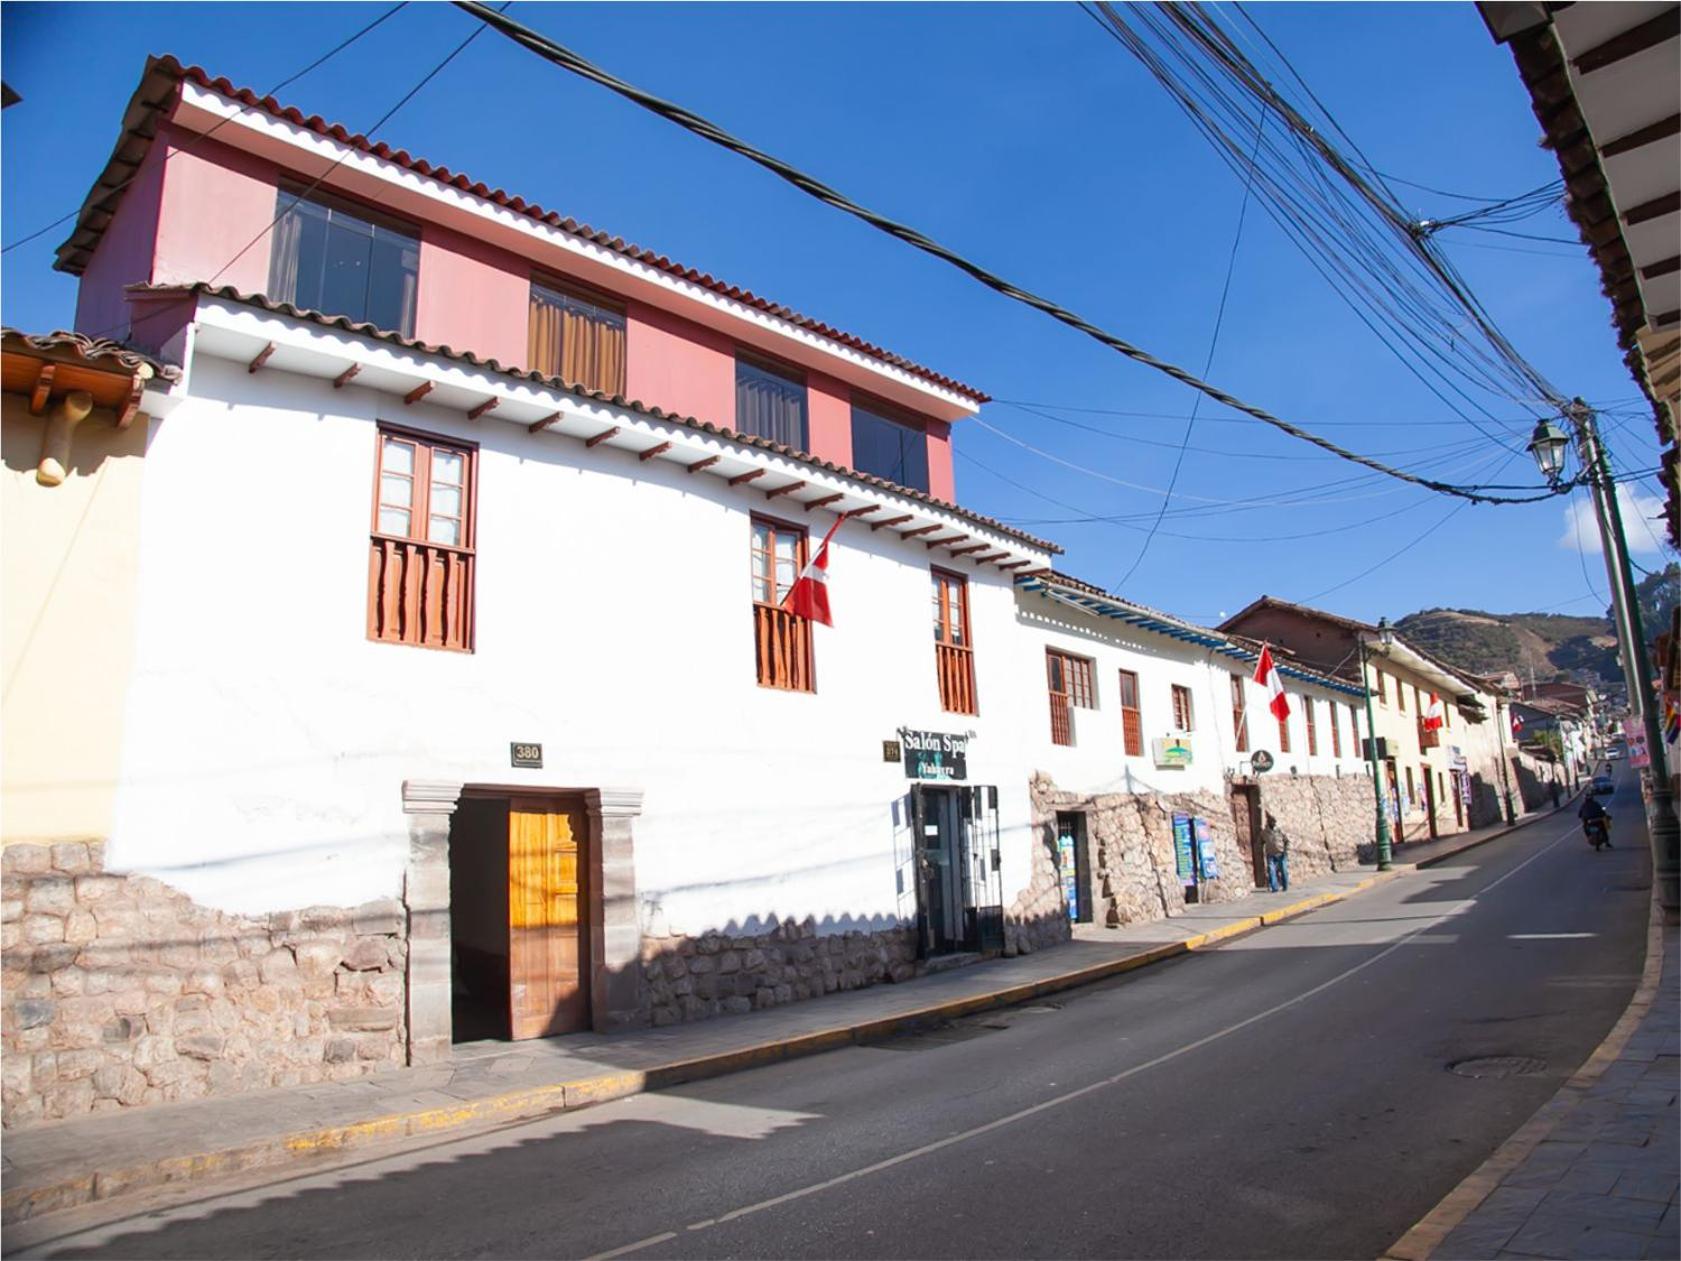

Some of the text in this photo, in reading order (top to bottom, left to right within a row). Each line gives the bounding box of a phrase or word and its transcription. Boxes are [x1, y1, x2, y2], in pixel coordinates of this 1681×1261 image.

[516, 745, 540, 759] 380
[904, 731, 966, 759] Salón Spa
